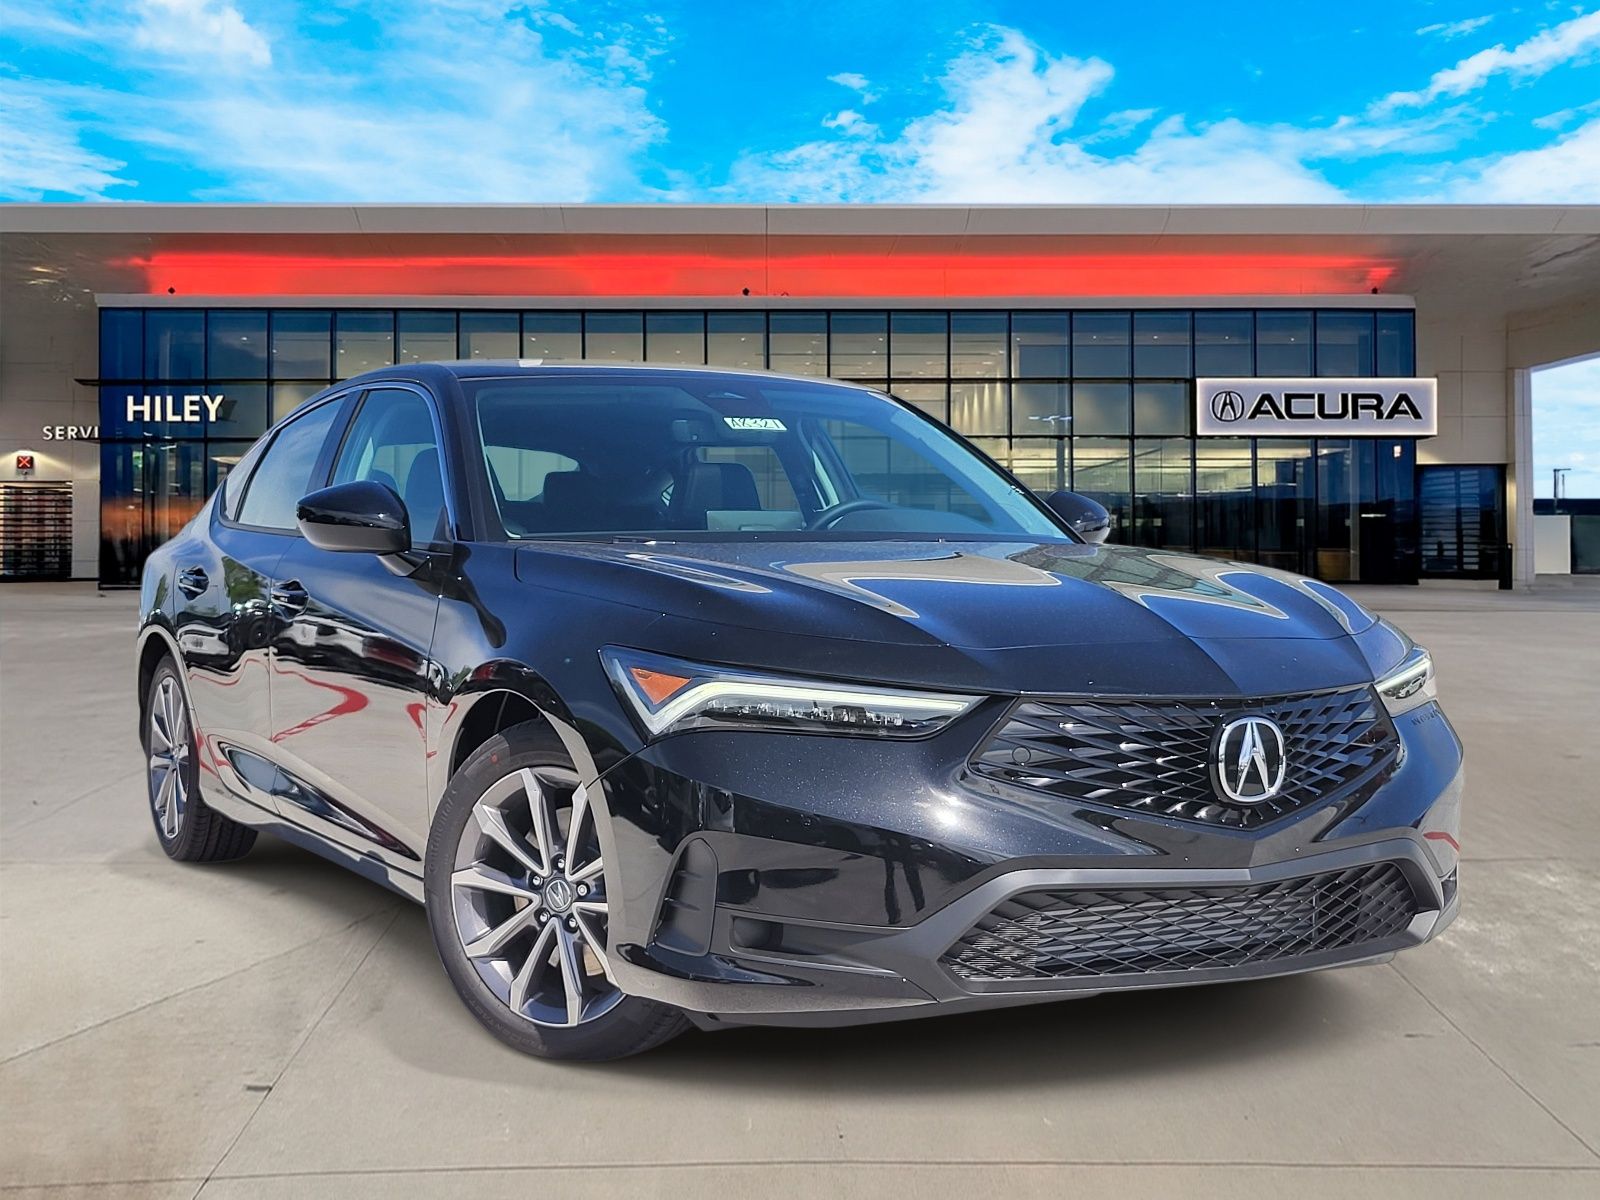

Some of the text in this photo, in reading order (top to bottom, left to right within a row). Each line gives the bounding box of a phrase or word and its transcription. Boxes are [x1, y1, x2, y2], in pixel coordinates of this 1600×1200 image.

[126, 395, 224, 422] HILEY
[1247, 392, 1423, 420] ACURA
[42, 425, 99, 441] SERVI
